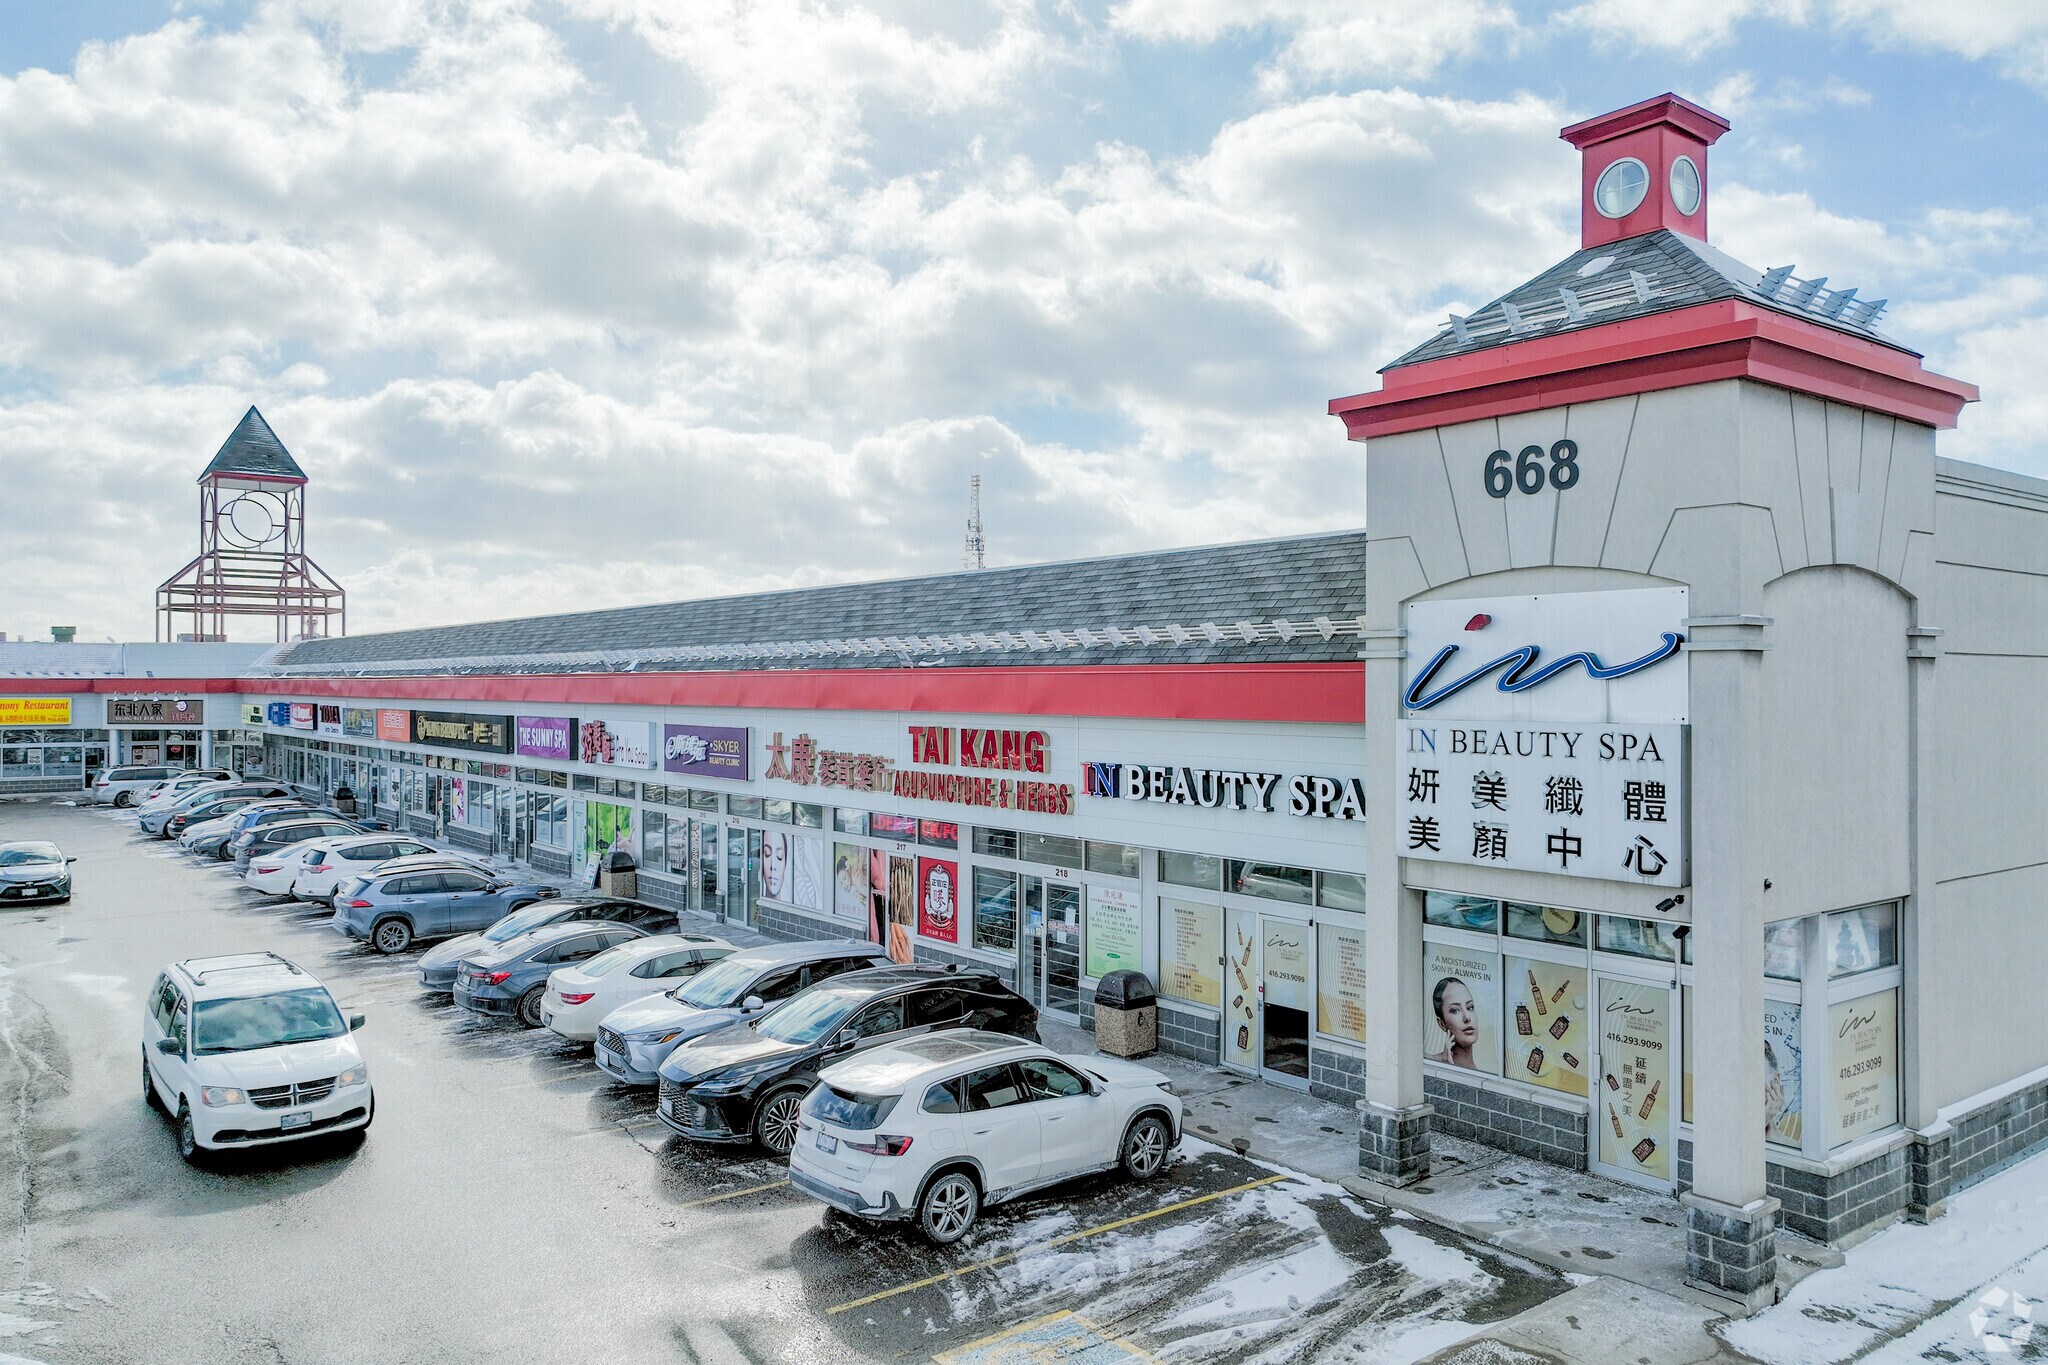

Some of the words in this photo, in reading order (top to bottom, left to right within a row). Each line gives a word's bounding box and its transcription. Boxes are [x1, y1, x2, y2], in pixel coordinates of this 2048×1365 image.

[1484, 439, 1579, 498] 668
[24, 700, 68, 710] Restaurant
[115, 703, 163, 716] 东北人家
[519, 727, 531, 746] THE
[532, 728, 553, 748] SUNNY
[554, 729, 567, 749] SPA
[713, 739, 740, 753] SKYER
[1407, 728, 1437, 753] IN
[1450, 729, 1583, 758] BEAUTY
[1599, 733, 1664, 762] SPA
[908, 725, 955, 766] TAI
[960, 728, 1051, 774] KANG
[894, 769, 998, 808] ACUPUNCTURE
[999, 778, 1013, 808] &
[1016, 781, 1075, 816] HERBS
[1081, 762, 1122, 798] IN
[1124, 763, 1282, 813] BEAUTY
[1288, 774, 1366, 821] SPA
[1056, 868, 1068, 878] 218
[1442, 956, 1487, 971] MOISTURIZED
[1268, 970, 1305, 983] 416.293.9099
[1432, 964, 1446, 973] SKIN
[1454, 968, 1482, 980] ALWAYS
[1484, 974, 1491, 982] IN
[1630, 1016, 1652, 1024] BEAUTY
[1772, 1026, 1782, 1036] IN
[1606, 1032, 1662, 1051] 416.293.9099
[1840, 1056, 1882, 1080] 416.293.9099
